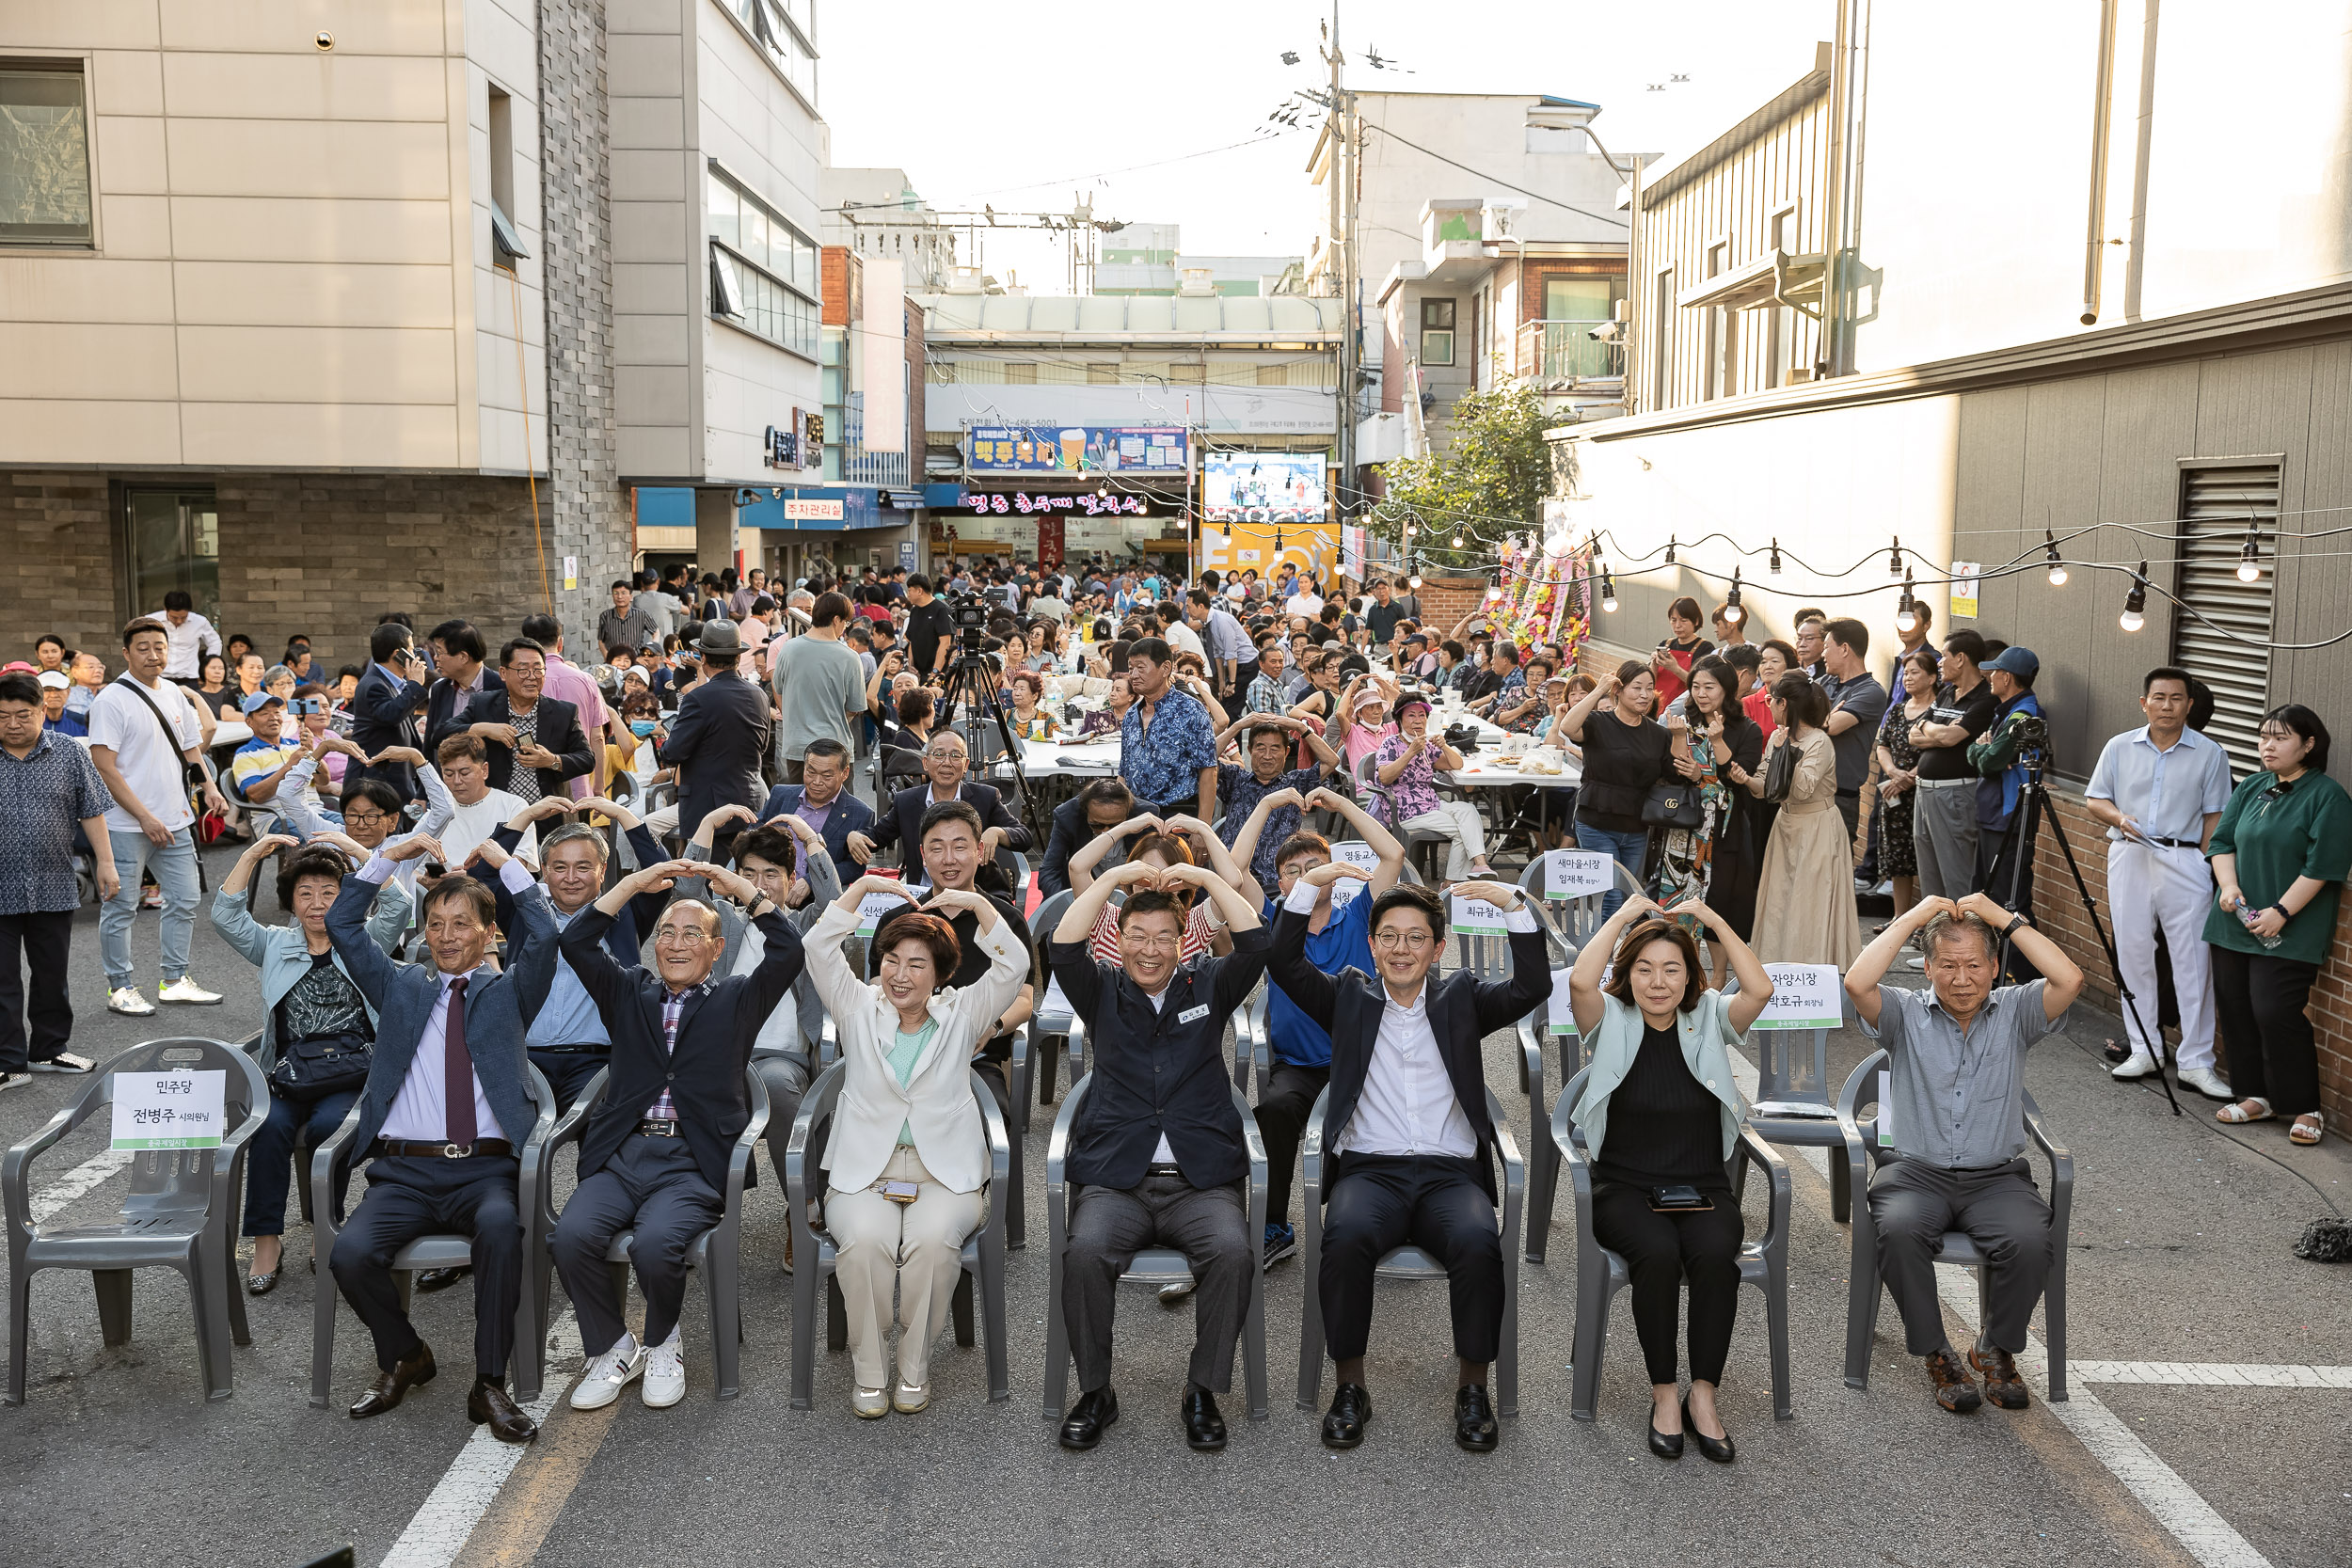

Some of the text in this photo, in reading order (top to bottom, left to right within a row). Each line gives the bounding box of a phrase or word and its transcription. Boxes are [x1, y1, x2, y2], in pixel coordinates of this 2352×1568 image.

[787, 504, 842, 516] 주차관리실
[968, 494, 1009, 513] 명동
[1014, 492, 1073, 513] 홍두깨
[1076, 494, 1139, 515] 칼국수
[1557, 858, 1601, 870] 새마을시장
[1559, 874, 1585, 885] 임재복
[1467, 906, 1494, 919] 최규철
[1772, 973, 1818, 986] 자양시장
[1769, 994, 1823, 1008] 박호규 회장님
[156, 1080, 193, 1094] 민주당
[134, 1108, 210, 1124] 전병주 시의원님
[147, 1138, 188, 1148] 중곡제일시장
